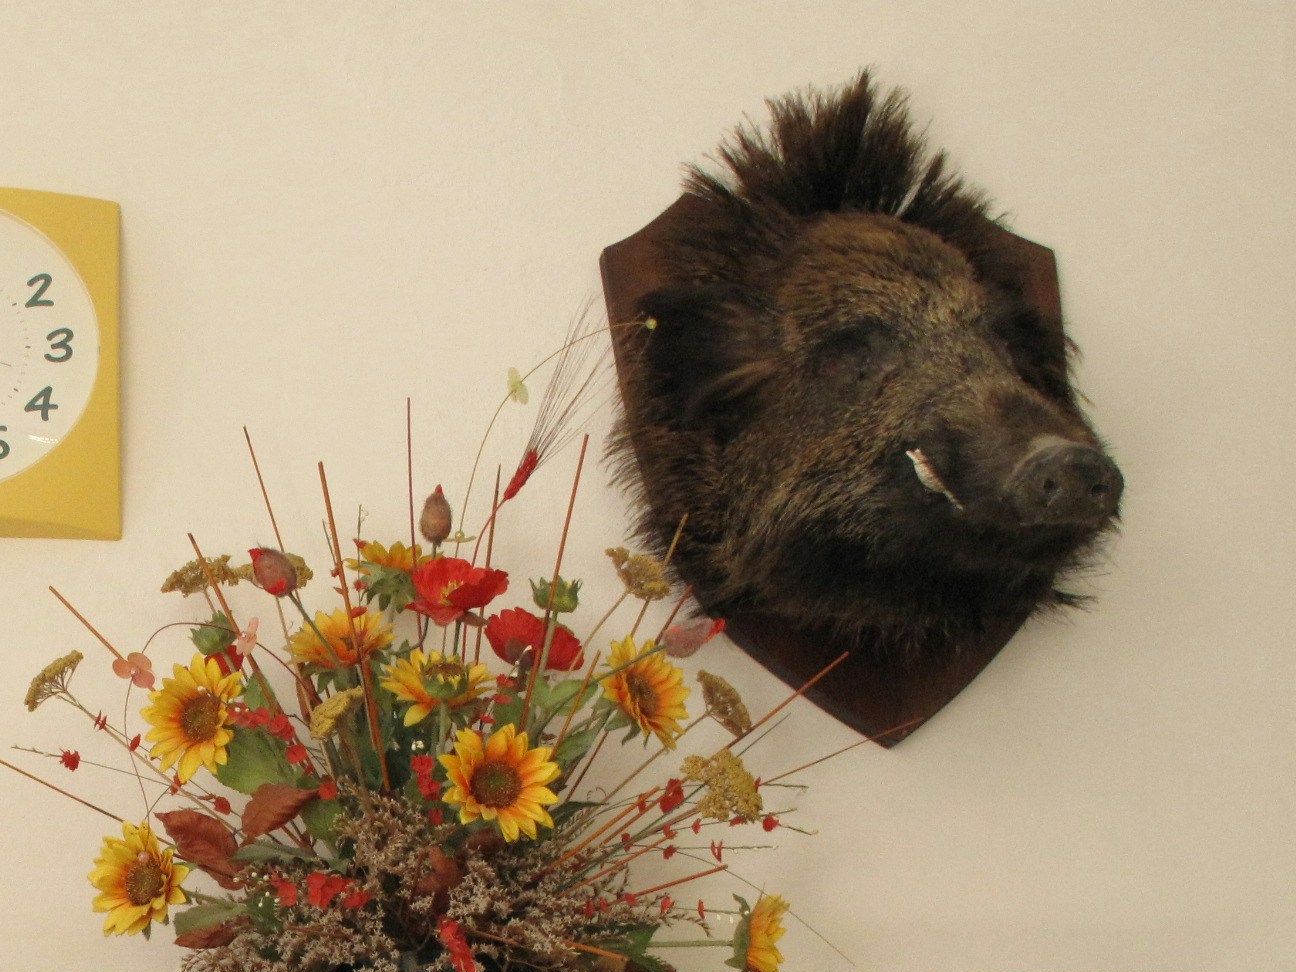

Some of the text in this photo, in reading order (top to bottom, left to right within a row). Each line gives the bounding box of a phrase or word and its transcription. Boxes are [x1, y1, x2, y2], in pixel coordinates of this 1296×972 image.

[24, 273, 54, 308] 2
[43, 327, 74, 363] 3
[24, 385, 59, 421] 4
